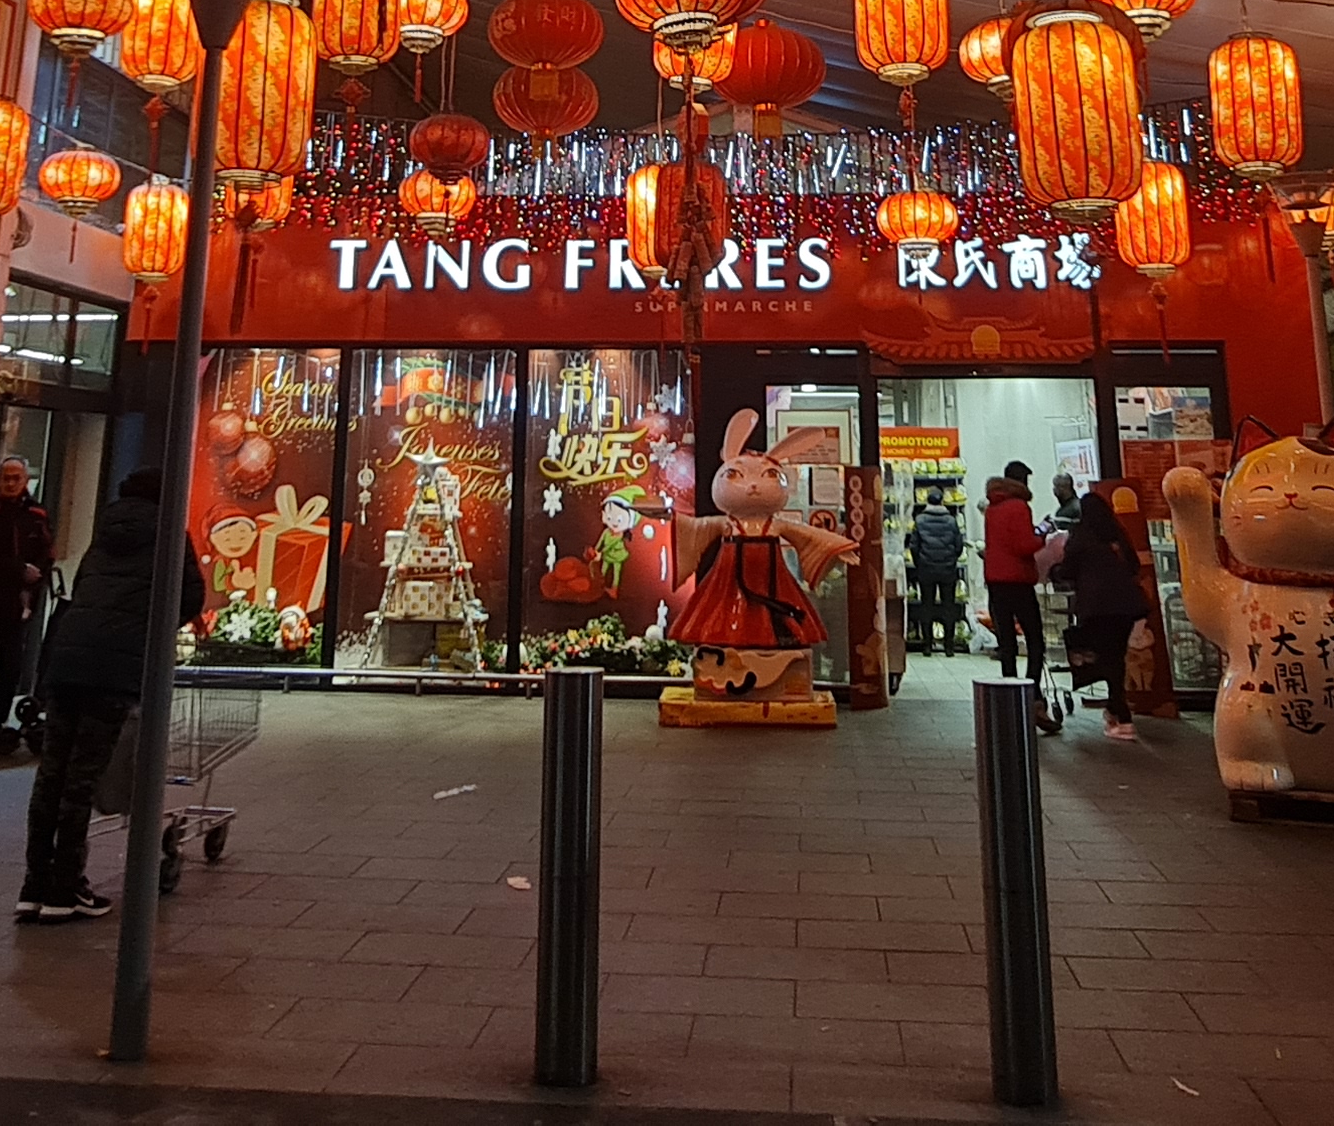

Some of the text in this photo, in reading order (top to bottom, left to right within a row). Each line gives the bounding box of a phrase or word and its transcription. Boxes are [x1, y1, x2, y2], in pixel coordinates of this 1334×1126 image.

[329, 237, 831, 290] TANG FRRES
[634, 300, 813, 313] SUPMARCHE
[259, 397, 359, 439] Greetins
[1270, 624, 1326, 735] 大開運
